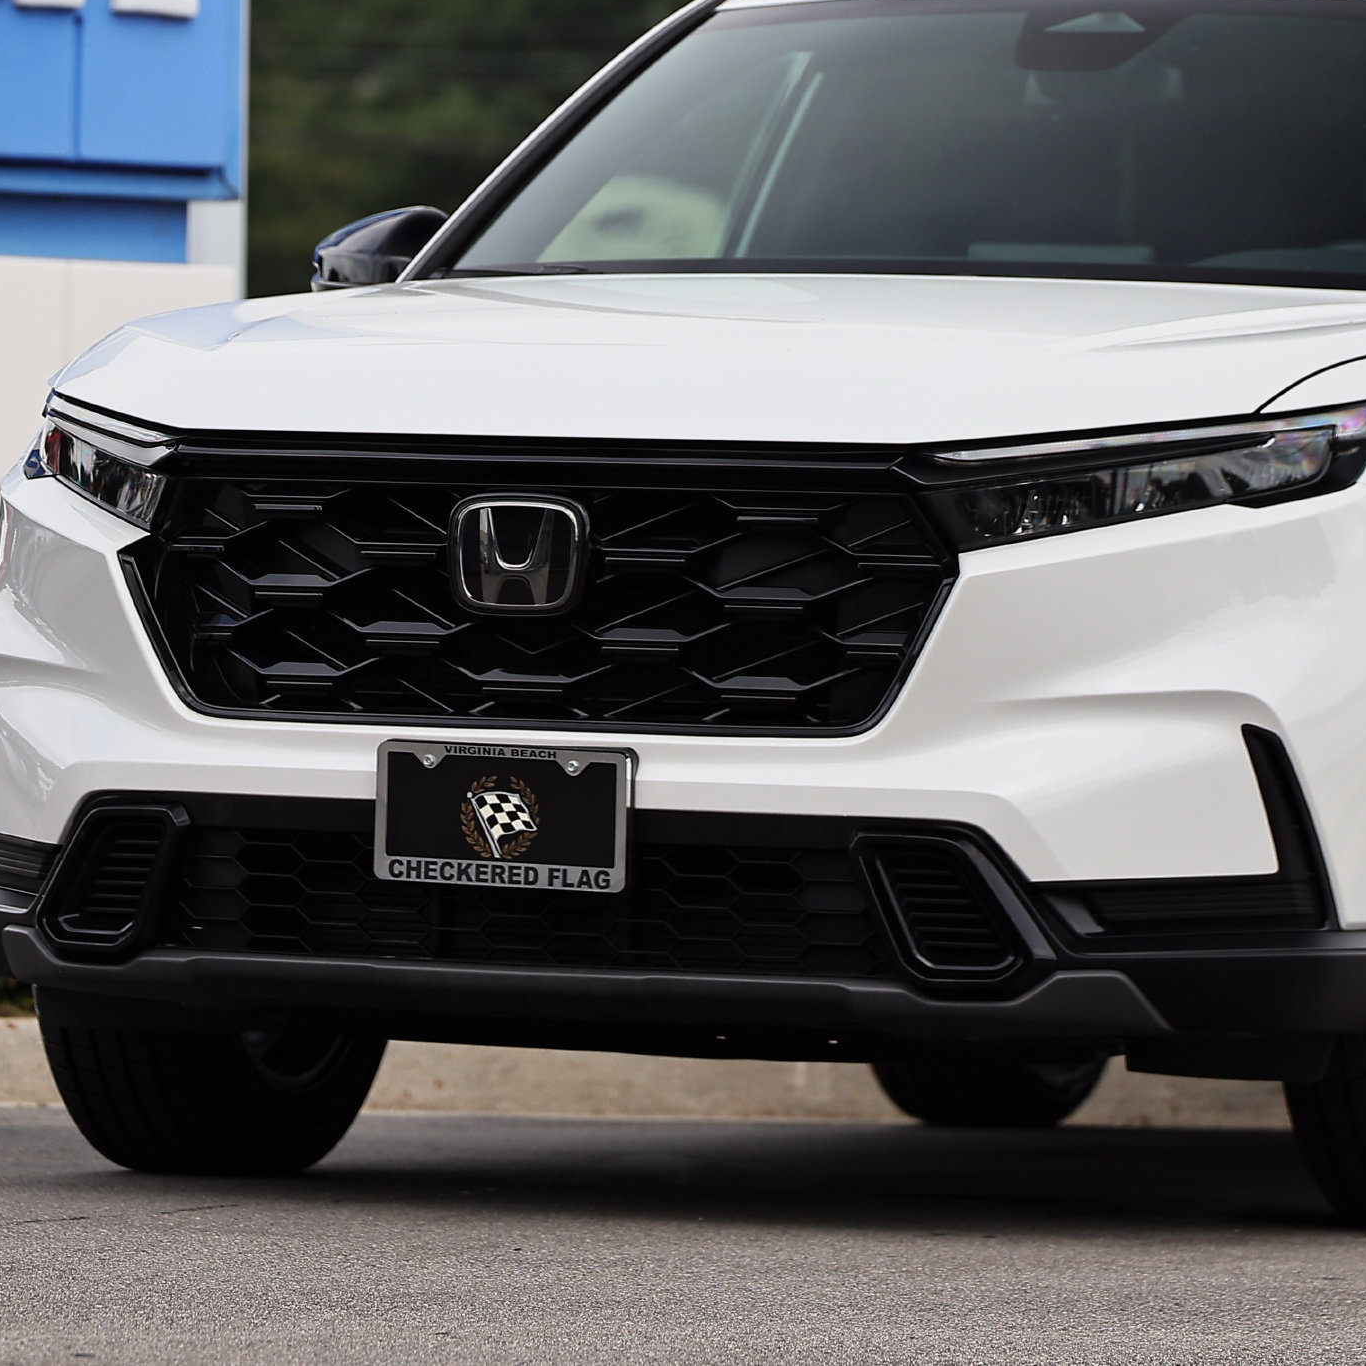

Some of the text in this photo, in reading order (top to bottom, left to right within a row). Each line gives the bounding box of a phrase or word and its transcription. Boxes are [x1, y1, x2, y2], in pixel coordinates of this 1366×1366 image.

[444, 745, 557, 759] VIRGINIA BEACH
[388, 859, 611, 890] CHECKERED FLAG
